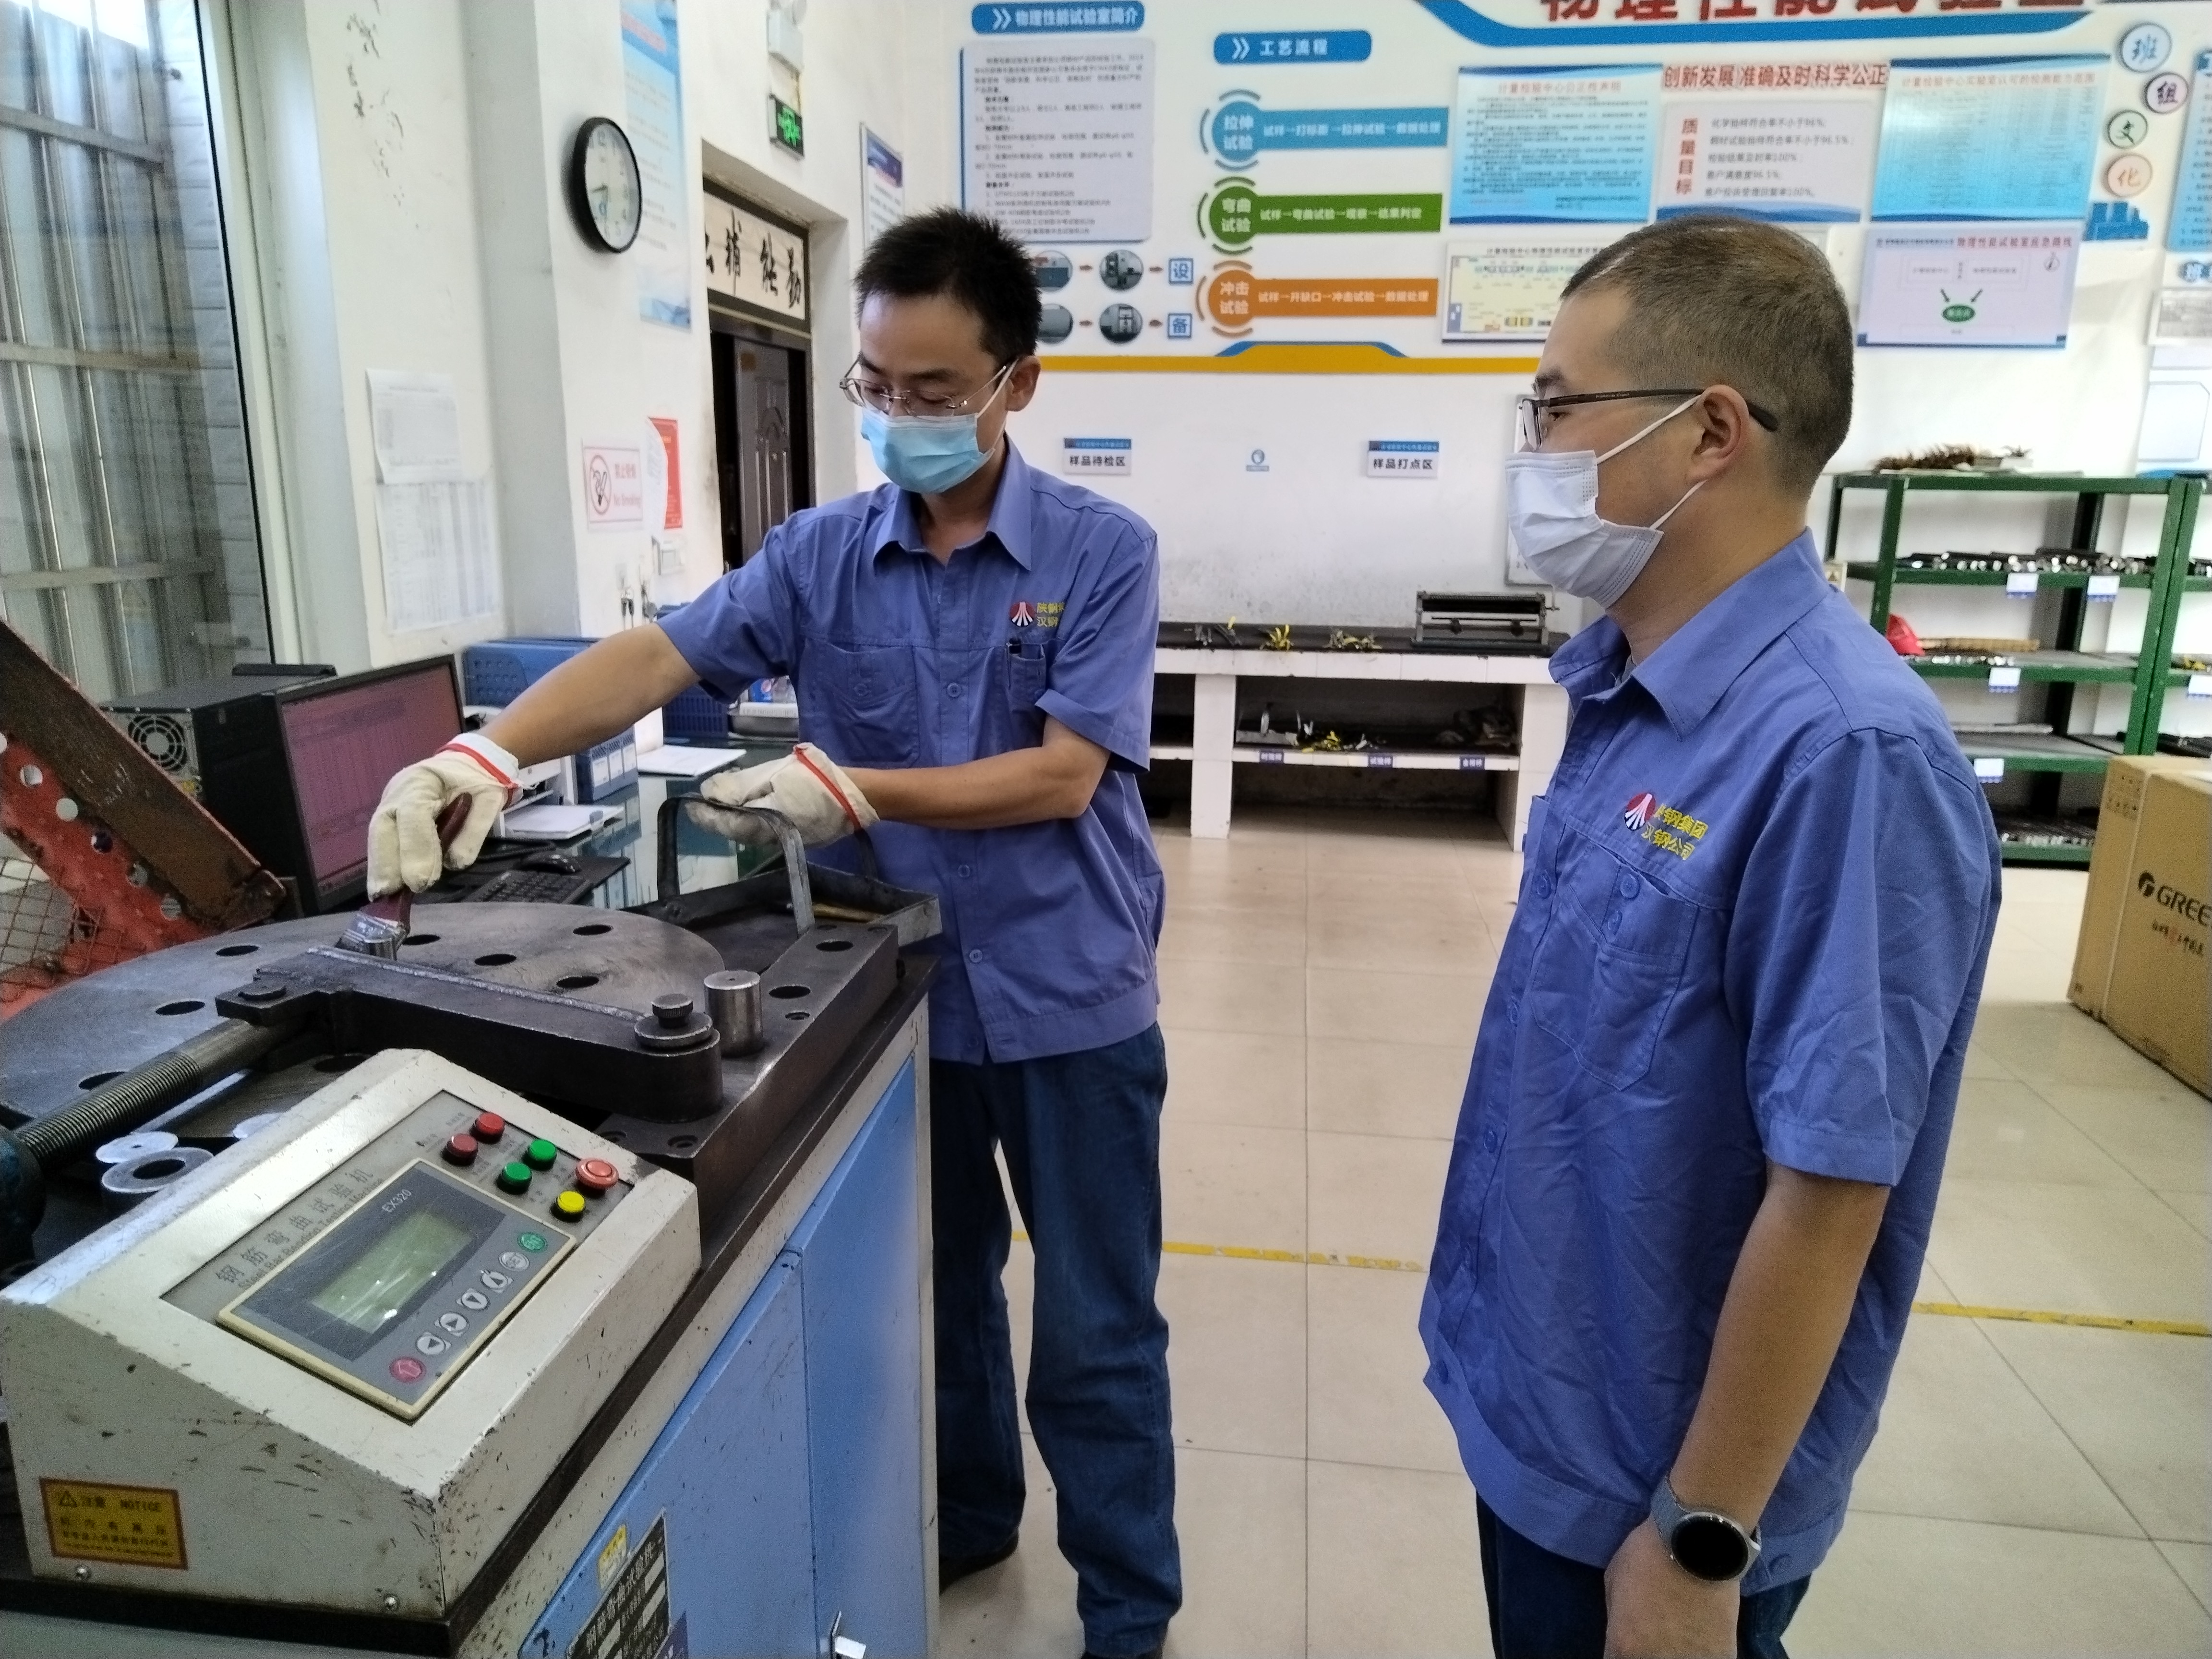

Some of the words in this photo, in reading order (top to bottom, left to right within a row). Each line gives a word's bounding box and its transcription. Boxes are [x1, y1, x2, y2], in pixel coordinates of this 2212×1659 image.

[1260, 38, 1328, 57] 工艺流程
[2132, 34, 2158, 63] 班
[1664, 65, 1735, 87] 创新发展
[1740, 63, 1887, 87] 准确及时科学公正
[2157, 81, 2178, 105] 组
[1223, 115, 1254, 131] 拉伸
[1223, 135, 1253, 150] 试验
[1675, 118, 1698, 194] 质量目标
[2117, 167, 2140, 187] 化
[1222, 198, 1251, 214] 弯曲
[1221, 217, 1251, 232] 试验
[1173, 263, 1189, 279] 设
[1220, 281, 1249, 296] 冲击
[1219, 301, 1249, 315] 试验
[1171, 317, 1188, 334] 备
[1070, 456, 1126, 466] 样品待检区
[1373, 458, 1433, 469] 样品打点区
[2157, 885, 2212, 926] GREE
[382, 1189, 412, 1213] EX320
[216, 1168, 373, 1283] 钢筋弯曲试验机
